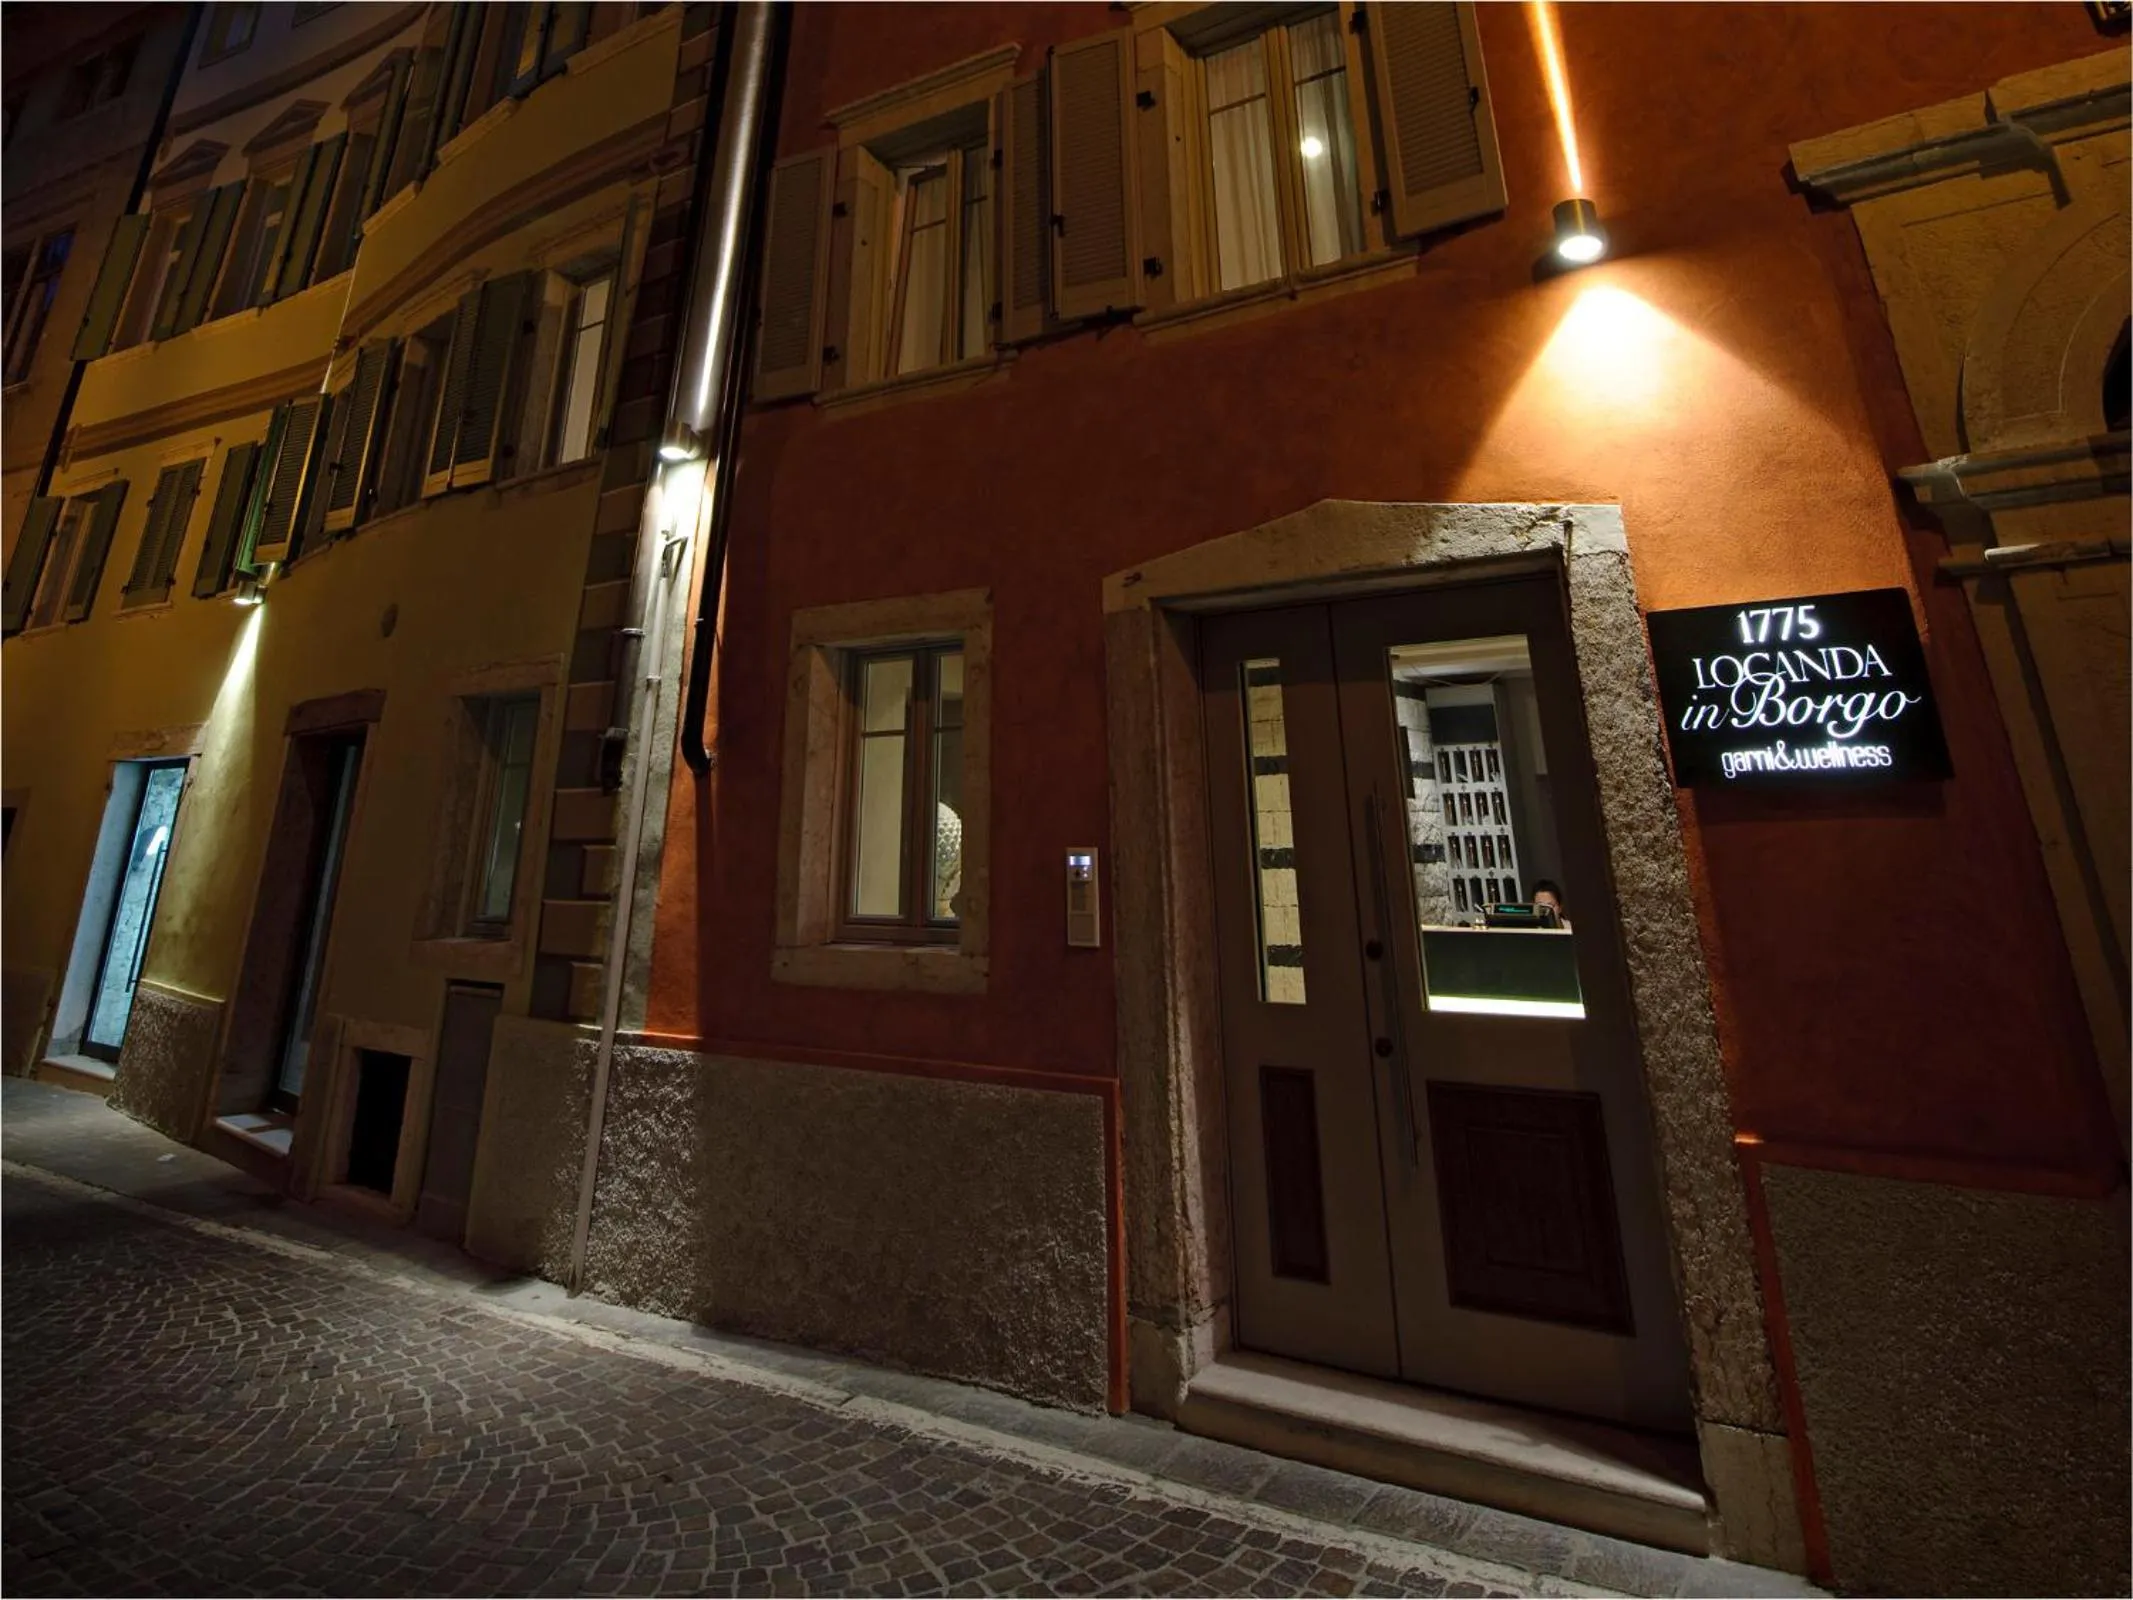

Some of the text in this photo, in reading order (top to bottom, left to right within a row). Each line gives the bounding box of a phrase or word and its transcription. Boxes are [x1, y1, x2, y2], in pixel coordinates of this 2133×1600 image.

[1737, 604, 1820, 643] 1775
[1692, 644, 1893, 688] LOCANDA
[1681, 671, 1922, 738] in Borgo
